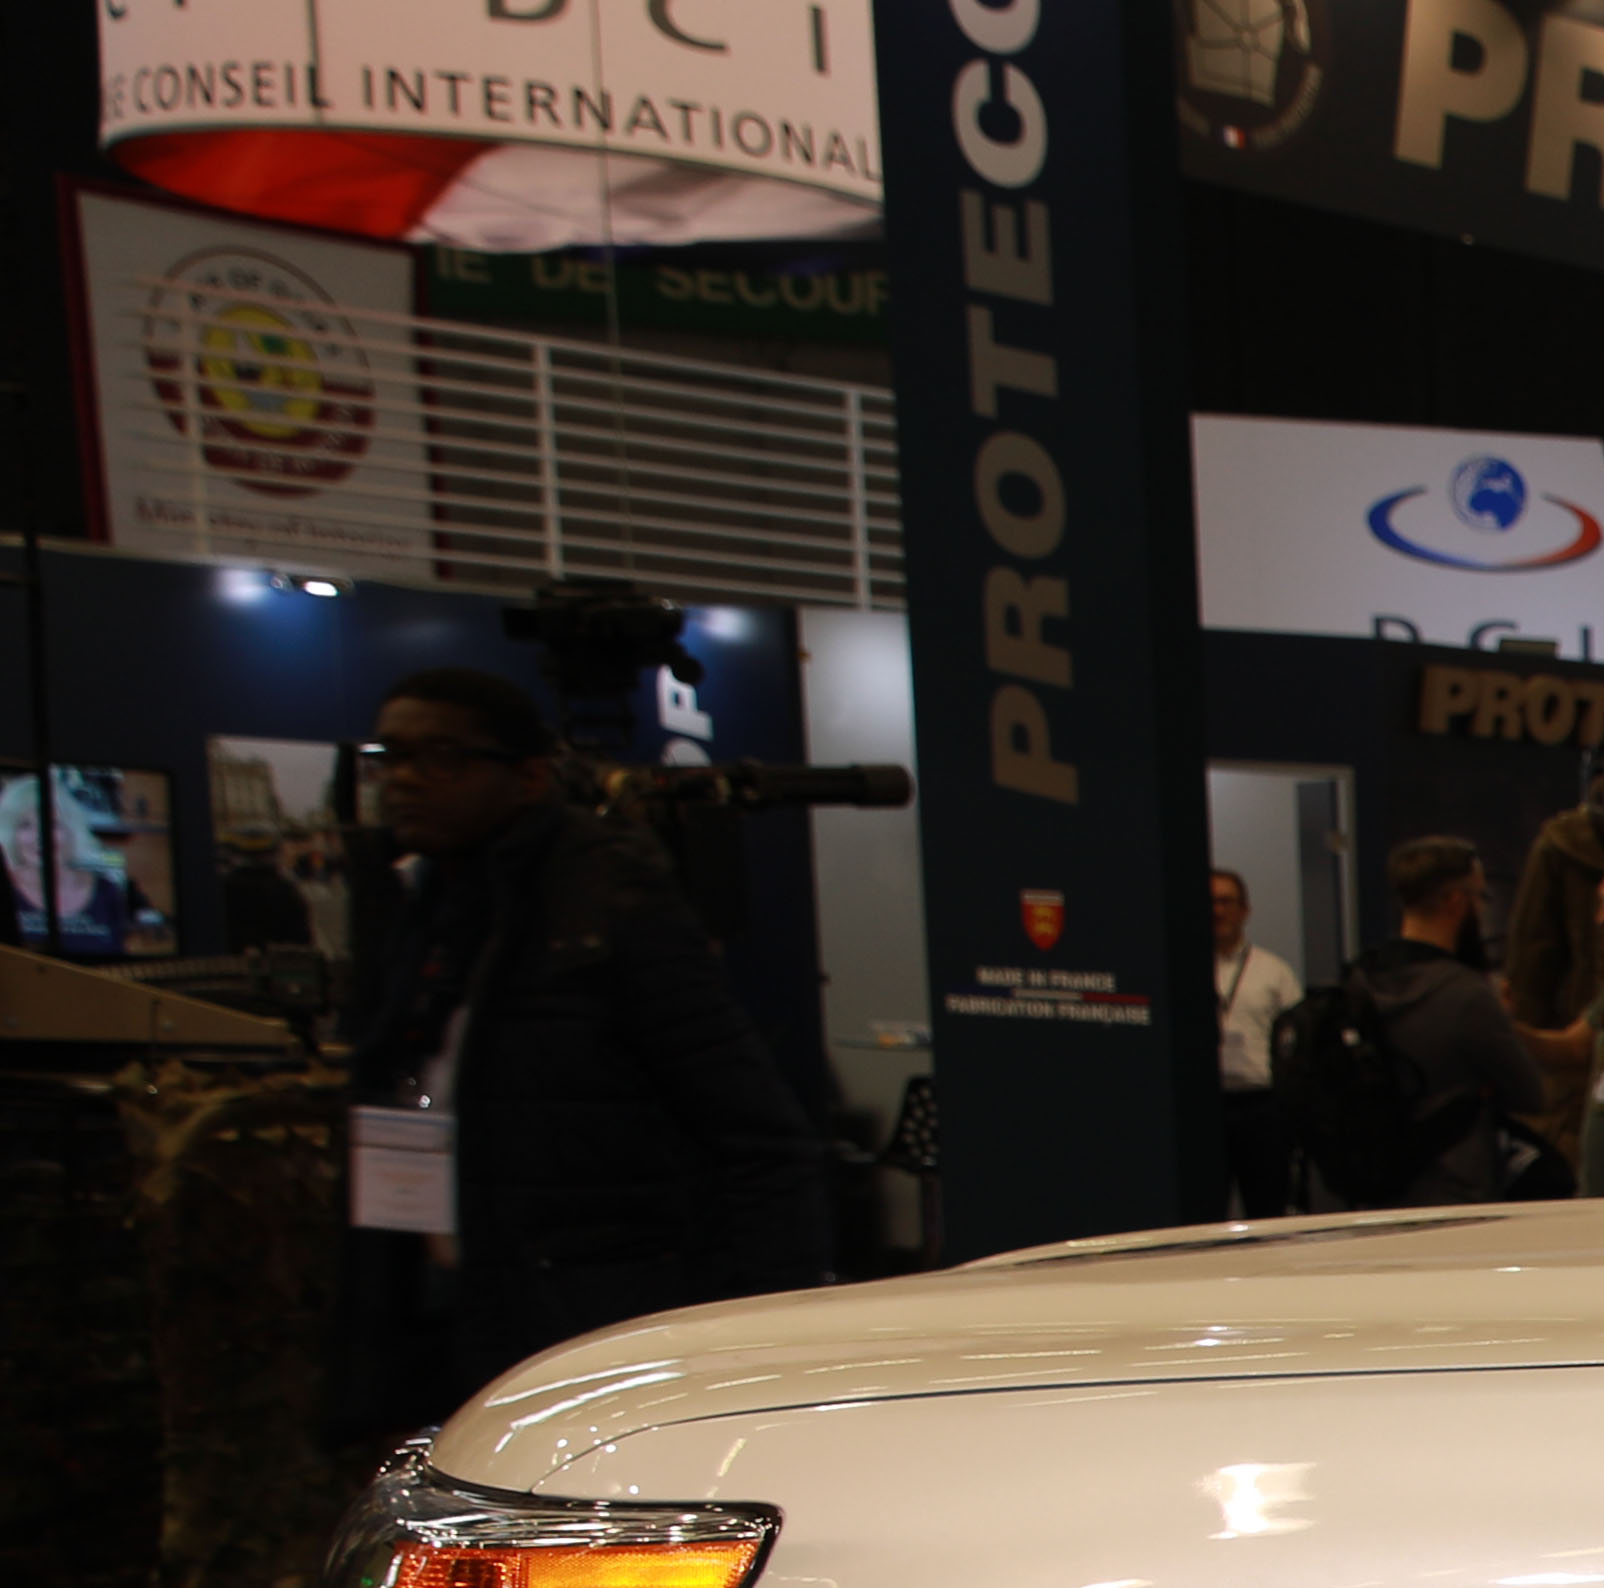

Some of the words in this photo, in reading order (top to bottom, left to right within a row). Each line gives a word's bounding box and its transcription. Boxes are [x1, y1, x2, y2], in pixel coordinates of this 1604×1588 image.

[134, 60, 334, 114] CONSEIL
[362, 66, 882, 182] INTERNATIONAL
[976, 966, 1024, 986] MADE
[1027, 968, 1046, 987] IN
[1048, 969, 1117, 992] FRANCE
[944, 993, 1054, 1018] FABRICATION
